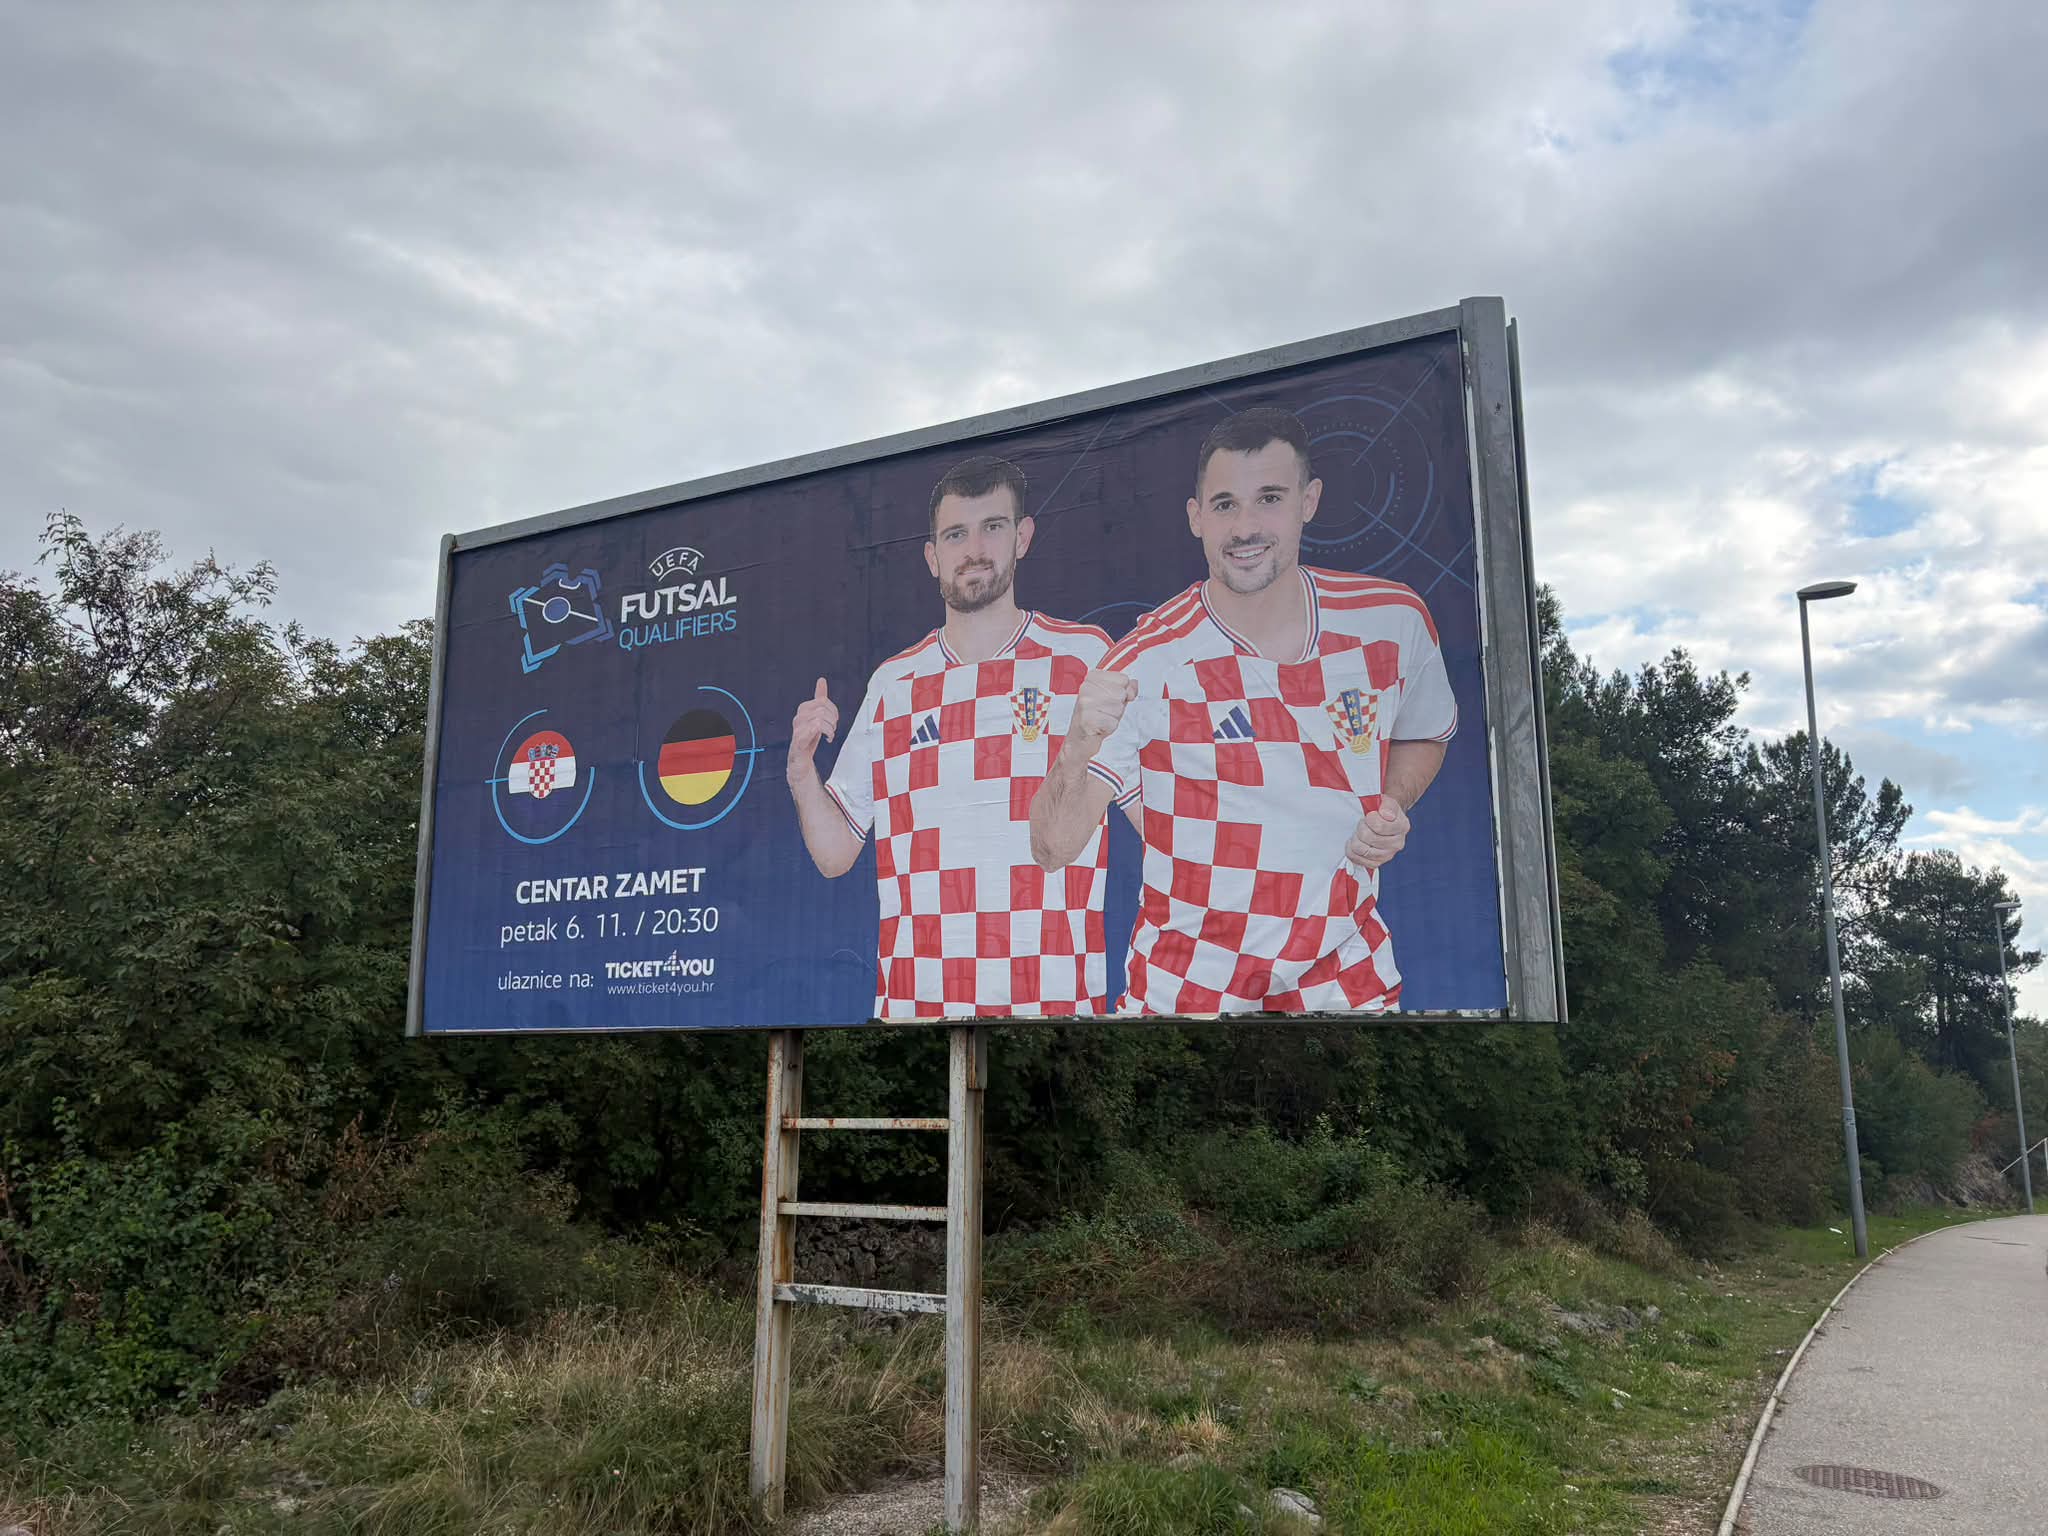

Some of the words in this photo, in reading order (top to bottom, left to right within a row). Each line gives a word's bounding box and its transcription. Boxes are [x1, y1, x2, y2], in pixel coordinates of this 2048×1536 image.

[652, 552, 699, 576] UEFA
[621, 577, 737, 623] FUTSAL
[620, 610, 737, 651] QUALIFIERS
[515, 875, 609, 904] CENTAR
[614, 867, 707, 898] ZAMET
[500, 916, 558, 949] petak
[566, 914, 586, 940] 6.
[596, 911, 627, 938] 11.
[652, 906, 719, 935] 20:30
[497, 969, 563, 991] ulaznice
[569, 972, 595, 989] na:
[604, 949, 716, 979] TICKET4YOU
[607, 980, 715, 996] www.ticket4you.hr
